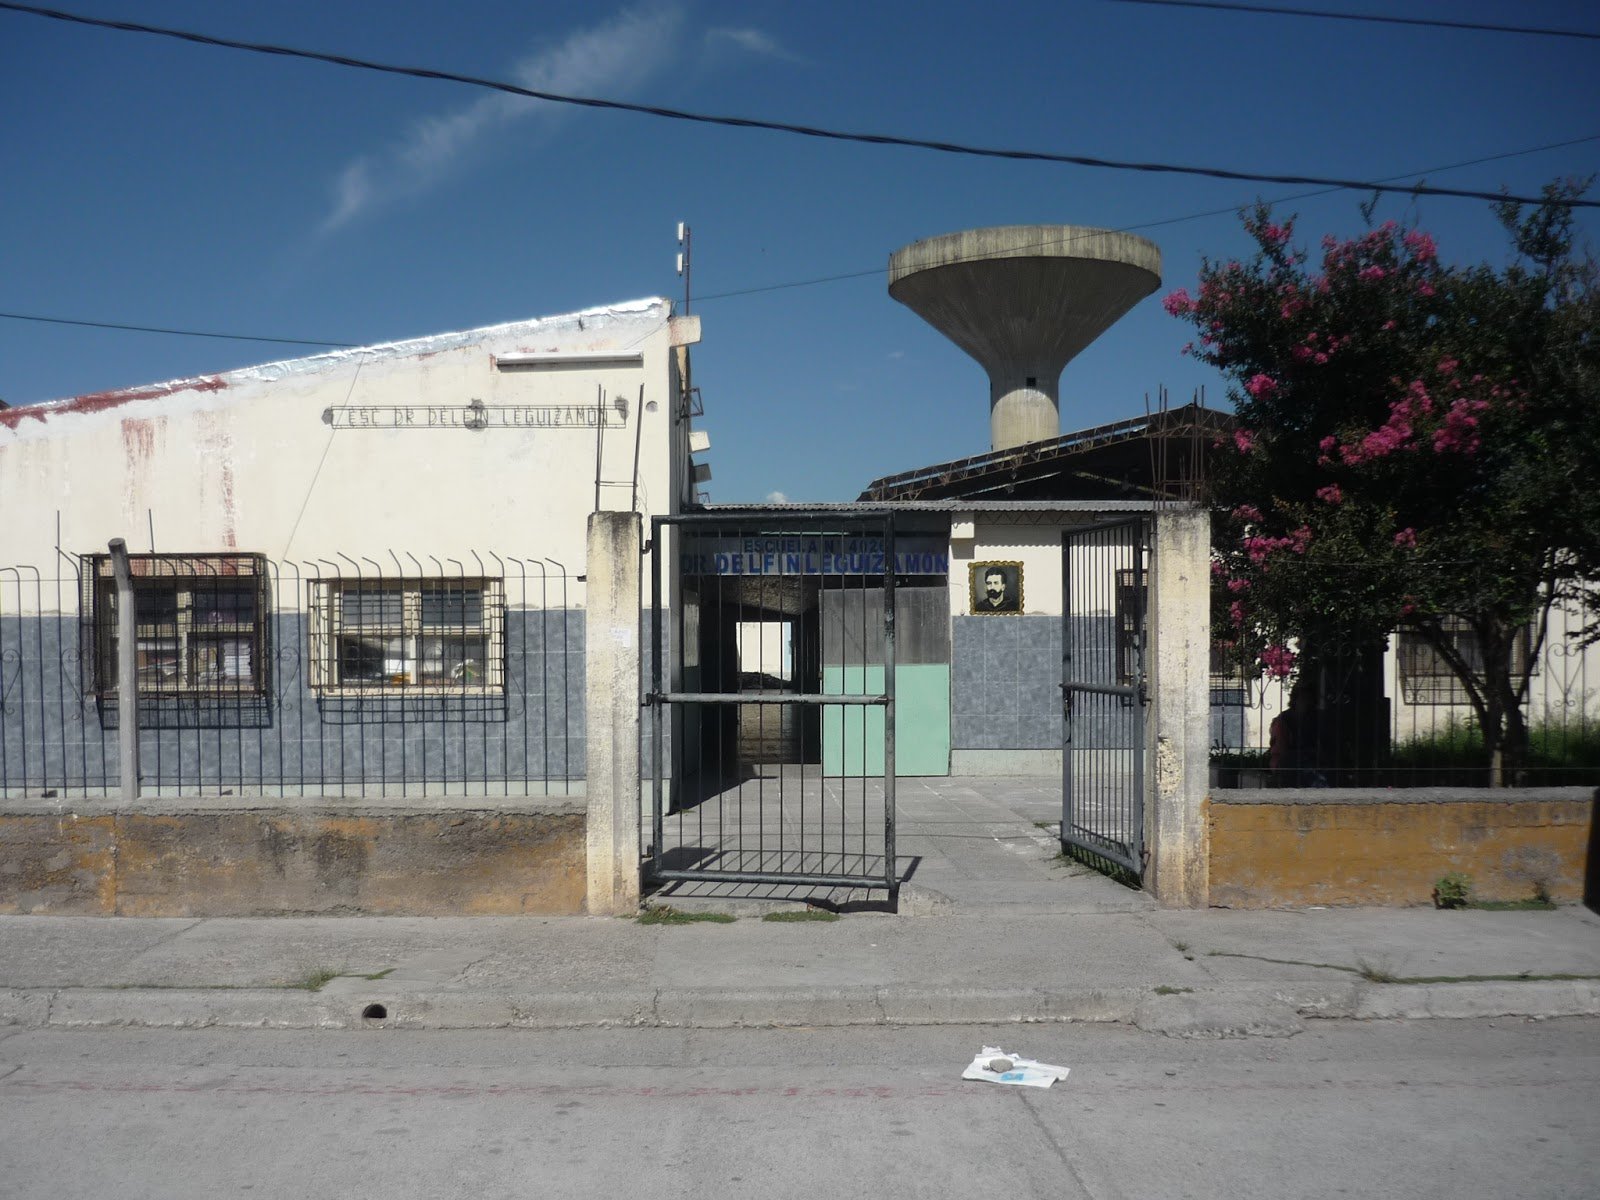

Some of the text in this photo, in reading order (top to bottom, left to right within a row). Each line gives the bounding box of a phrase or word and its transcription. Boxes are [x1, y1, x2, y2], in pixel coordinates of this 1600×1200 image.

[348, 407, 380, 426] ESC
[394, 407, 415, 426] DR
[744, 540, 817, 553] ESCUELA
